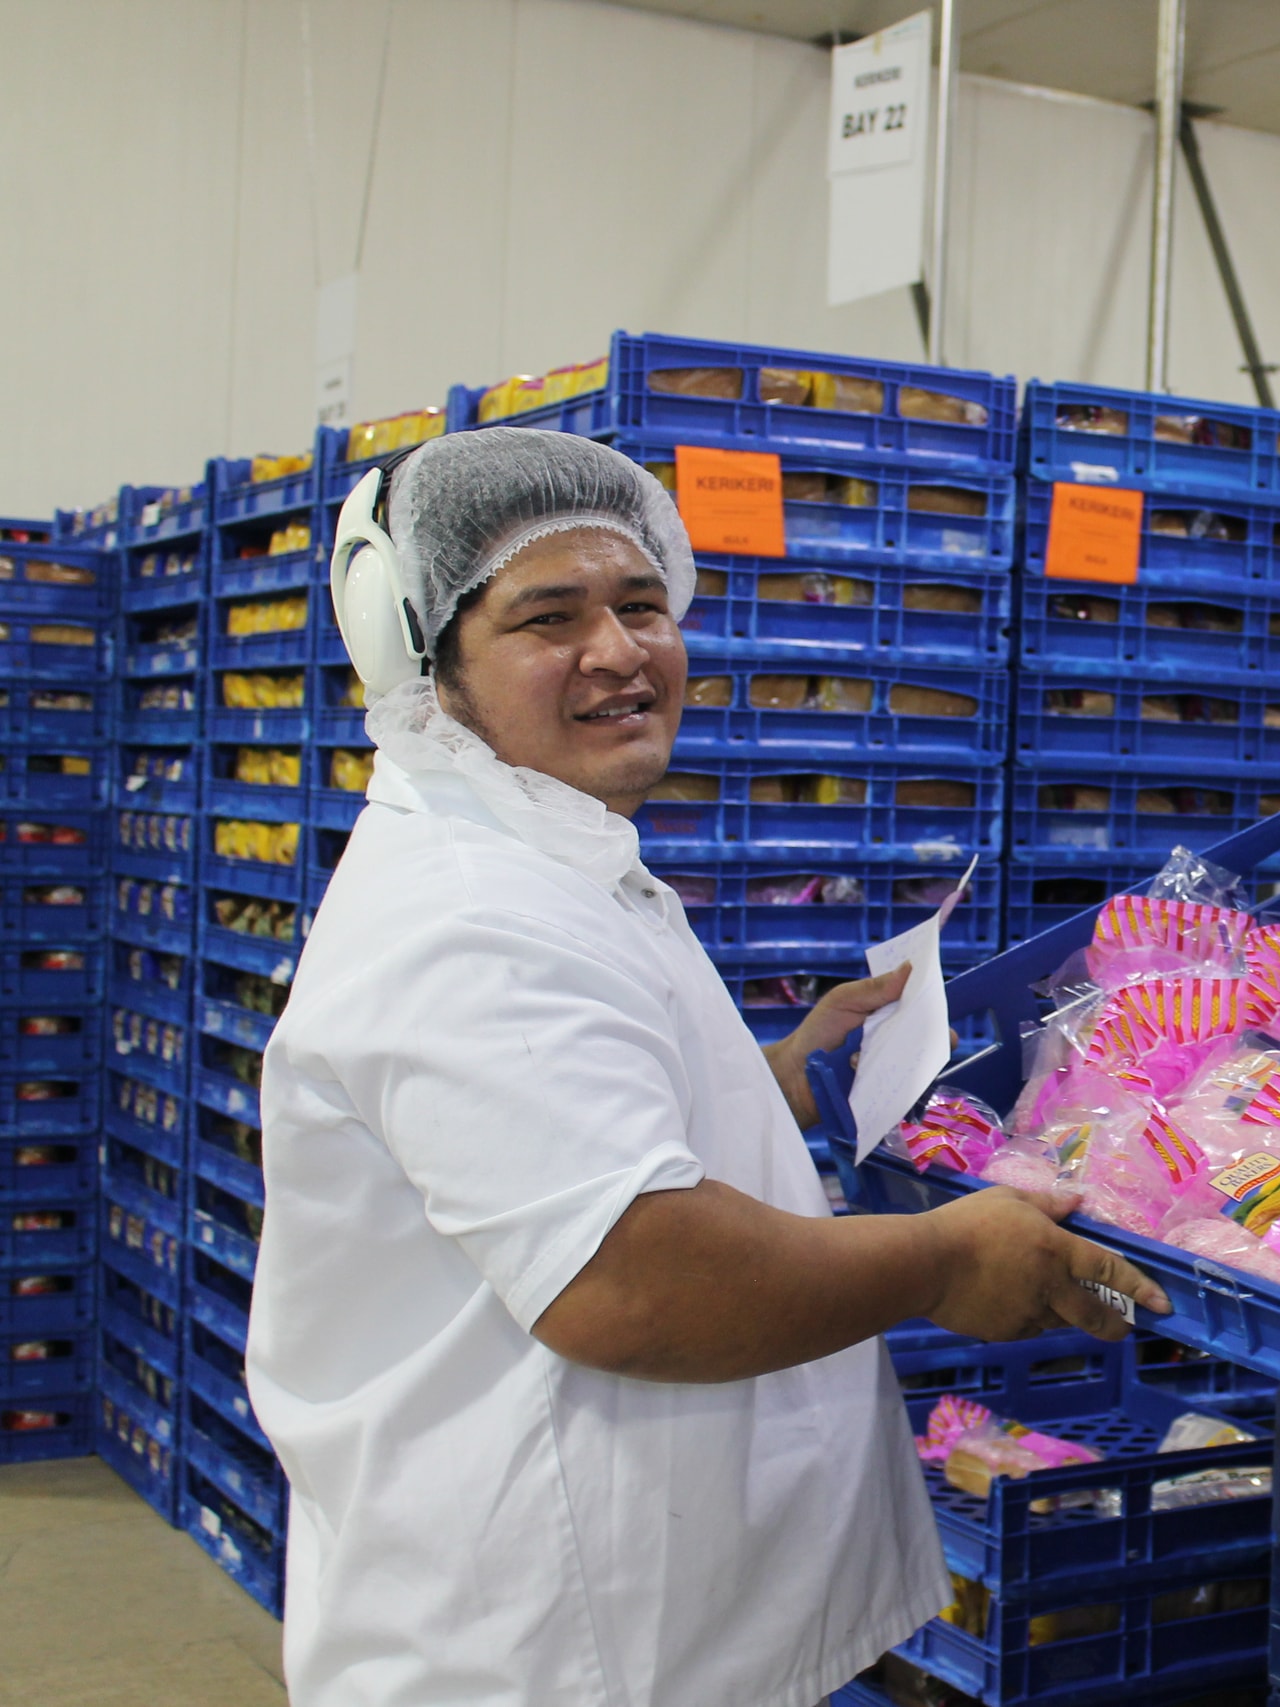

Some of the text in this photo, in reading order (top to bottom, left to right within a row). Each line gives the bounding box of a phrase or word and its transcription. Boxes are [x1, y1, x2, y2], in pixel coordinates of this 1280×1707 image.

[842, 103, 907, 139] BAY 22
[695, 476, 775, 492] KERIKERI
[1219, 1156, 1269, 1187] QUALITY
[1231, 1163, 1273, 1188] BAKERS
